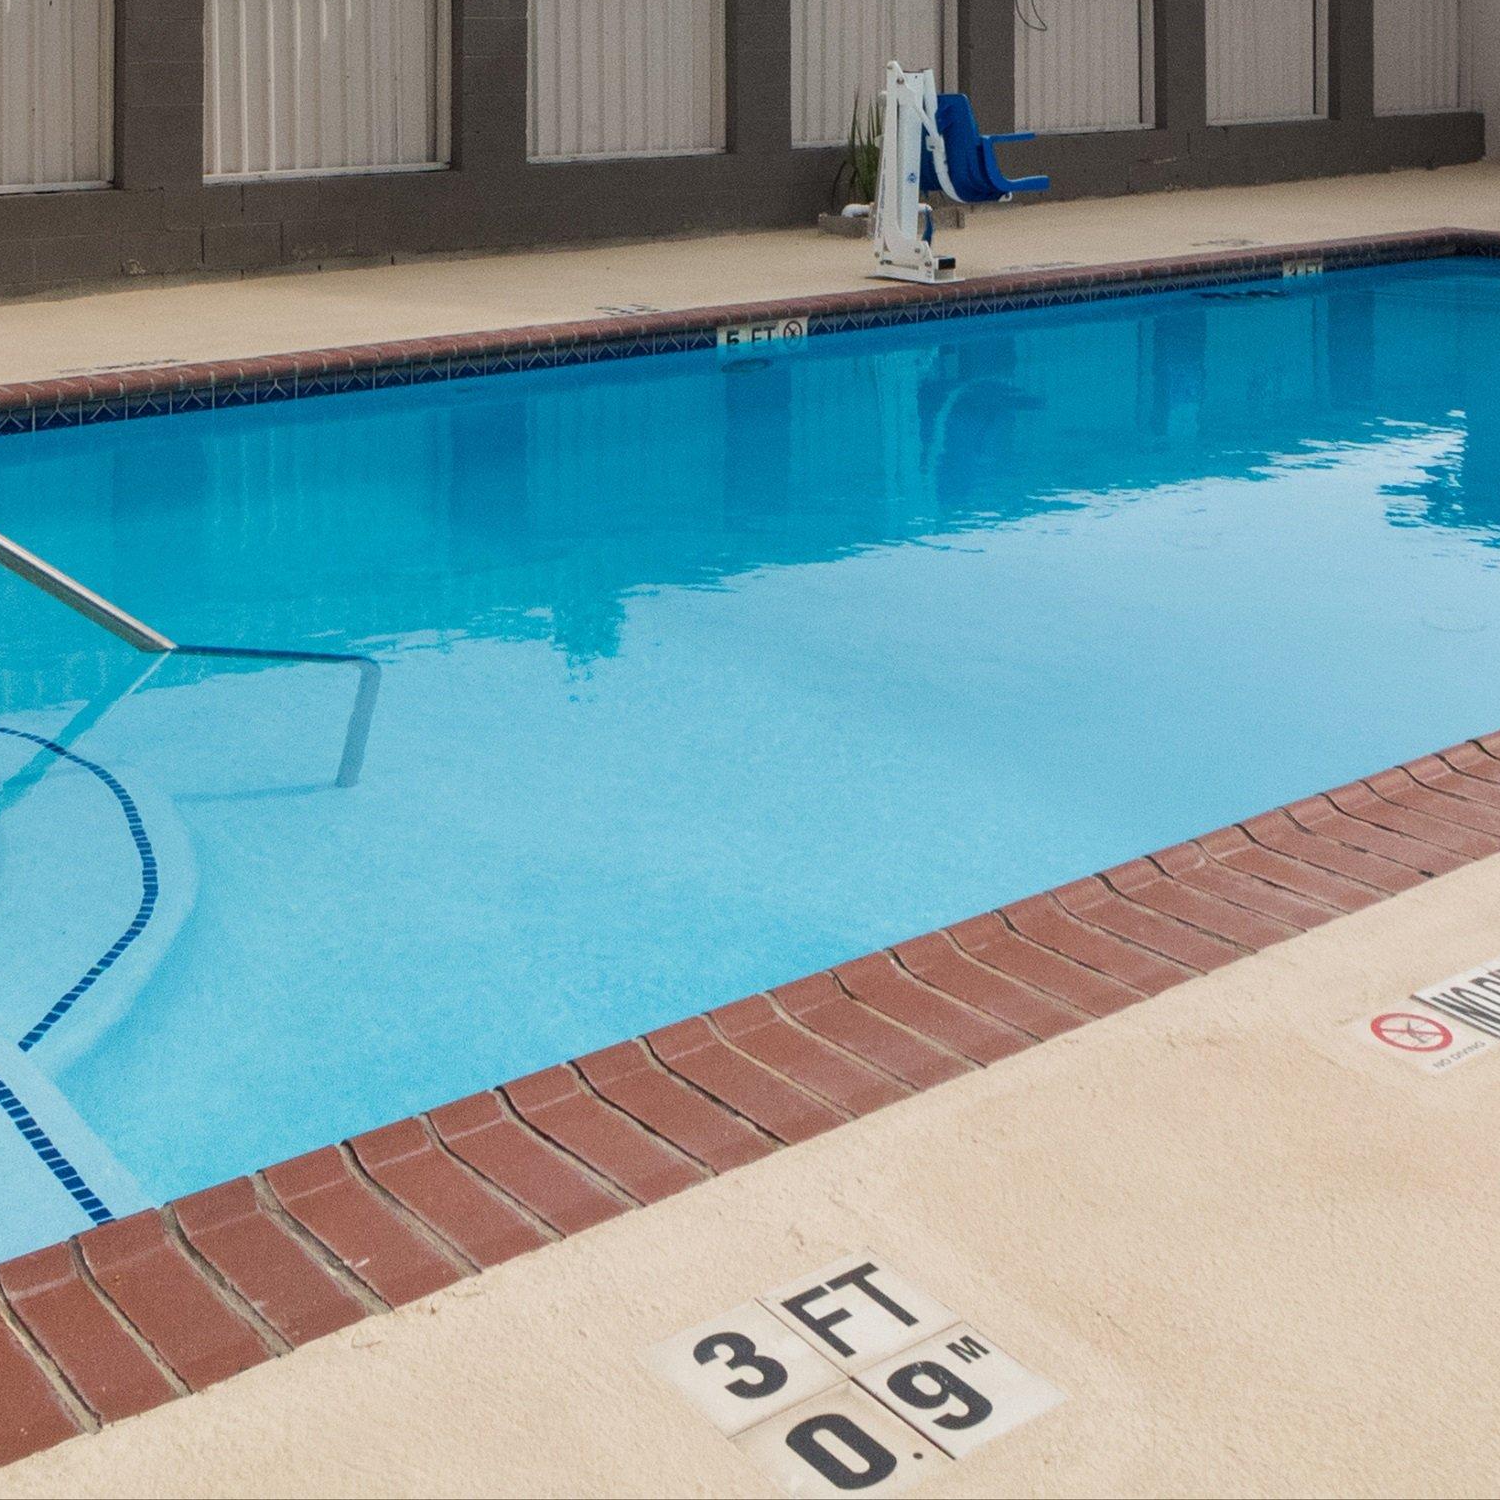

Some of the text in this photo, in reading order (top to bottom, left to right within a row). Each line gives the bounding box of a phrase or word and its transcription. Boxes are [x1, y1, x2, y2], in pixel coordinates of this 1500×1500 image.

[726, 327, 777, 345] 5 FT
[693, 1261, 920, 1400] 3 FT
